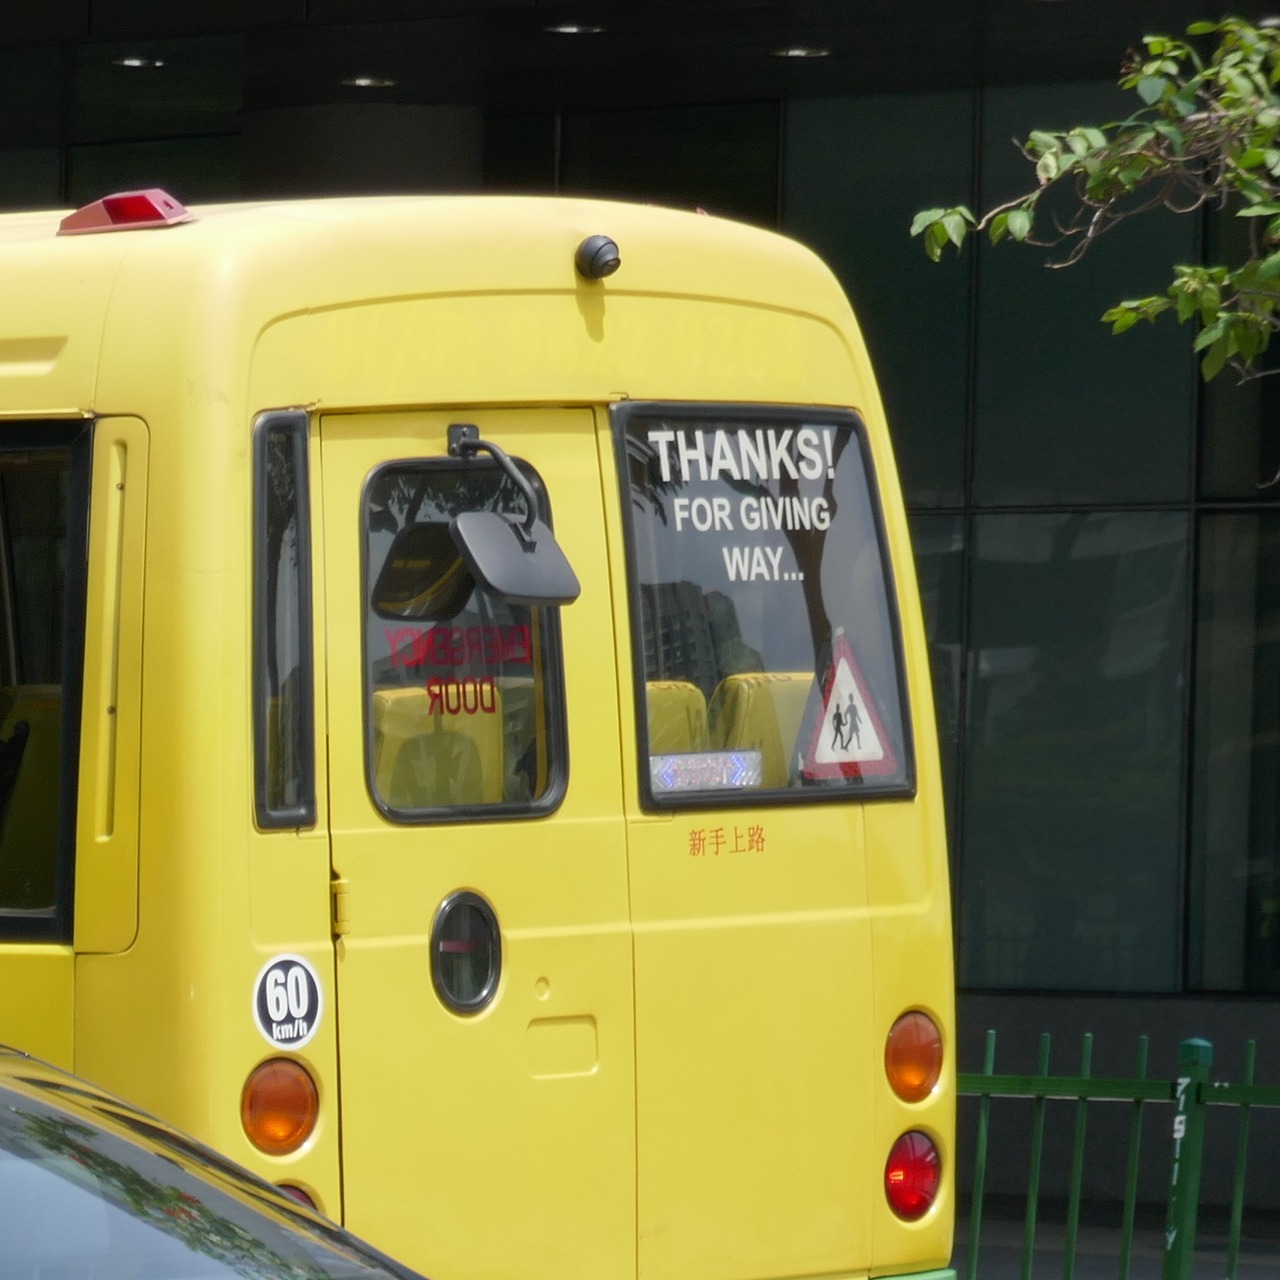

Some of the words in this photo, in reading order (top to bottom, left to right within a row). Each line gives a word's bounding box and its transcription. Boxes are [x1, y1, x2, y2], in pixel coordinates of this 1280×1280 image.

[647, 429, 835, 482] THANKS!
[673, 497, 734, 532] FOR
[740, 496, 831, 531] GIVING
[722, 547, 804, 581] WAY...
[689, 824, 766, 857] 新手上路
[265, 966, 308, 1022] 60
[272, 1019, 308, 1040] km/h
